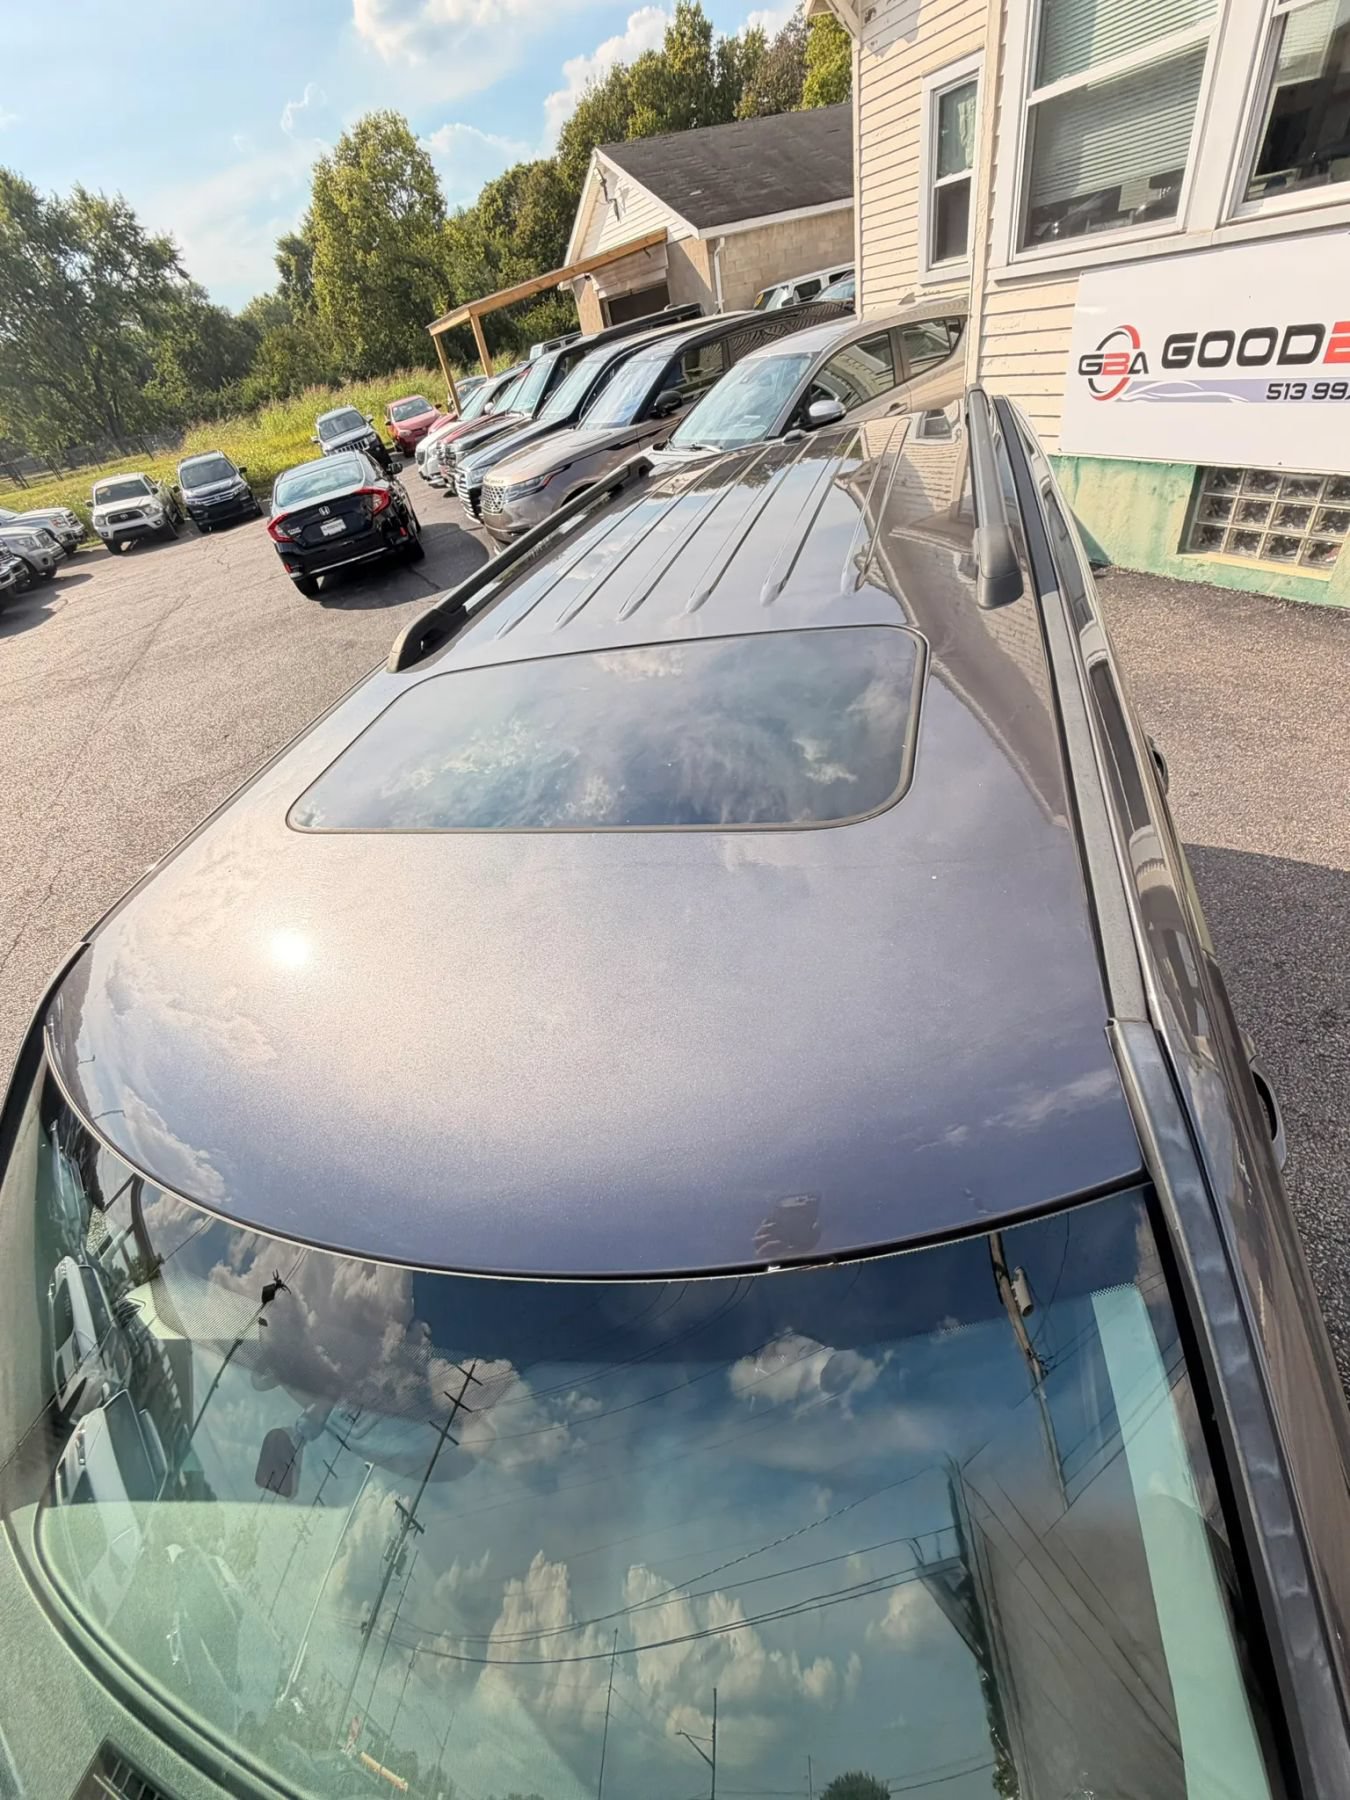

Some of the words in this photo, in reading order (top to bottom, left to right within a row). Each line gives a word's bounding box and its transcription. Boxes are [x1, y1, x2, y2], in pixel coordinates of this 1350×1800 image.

[1078, 351, 1149, 376] GBA
[1266, 382, 1307, 400] 513
[1311, 382, 1350, 400] 99
